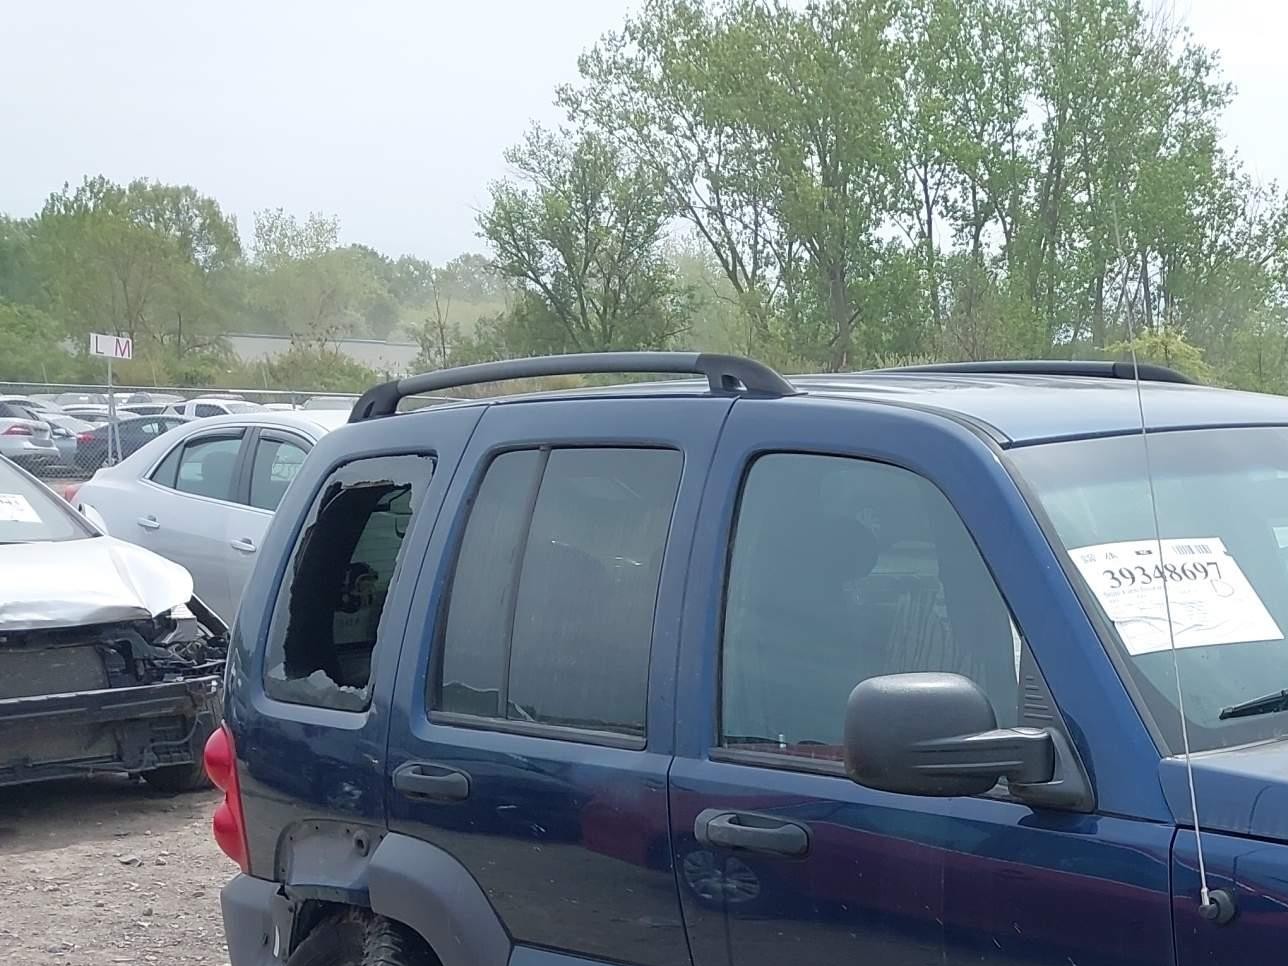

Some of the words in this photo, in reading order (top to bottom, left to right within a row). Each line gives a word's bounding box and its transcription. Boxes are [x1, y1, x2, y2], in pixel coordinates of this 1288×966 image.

[95, 335, 105, 355] L
[114, 338, 131, 358] M
[1102, 561, 1222, 589] 39348697
